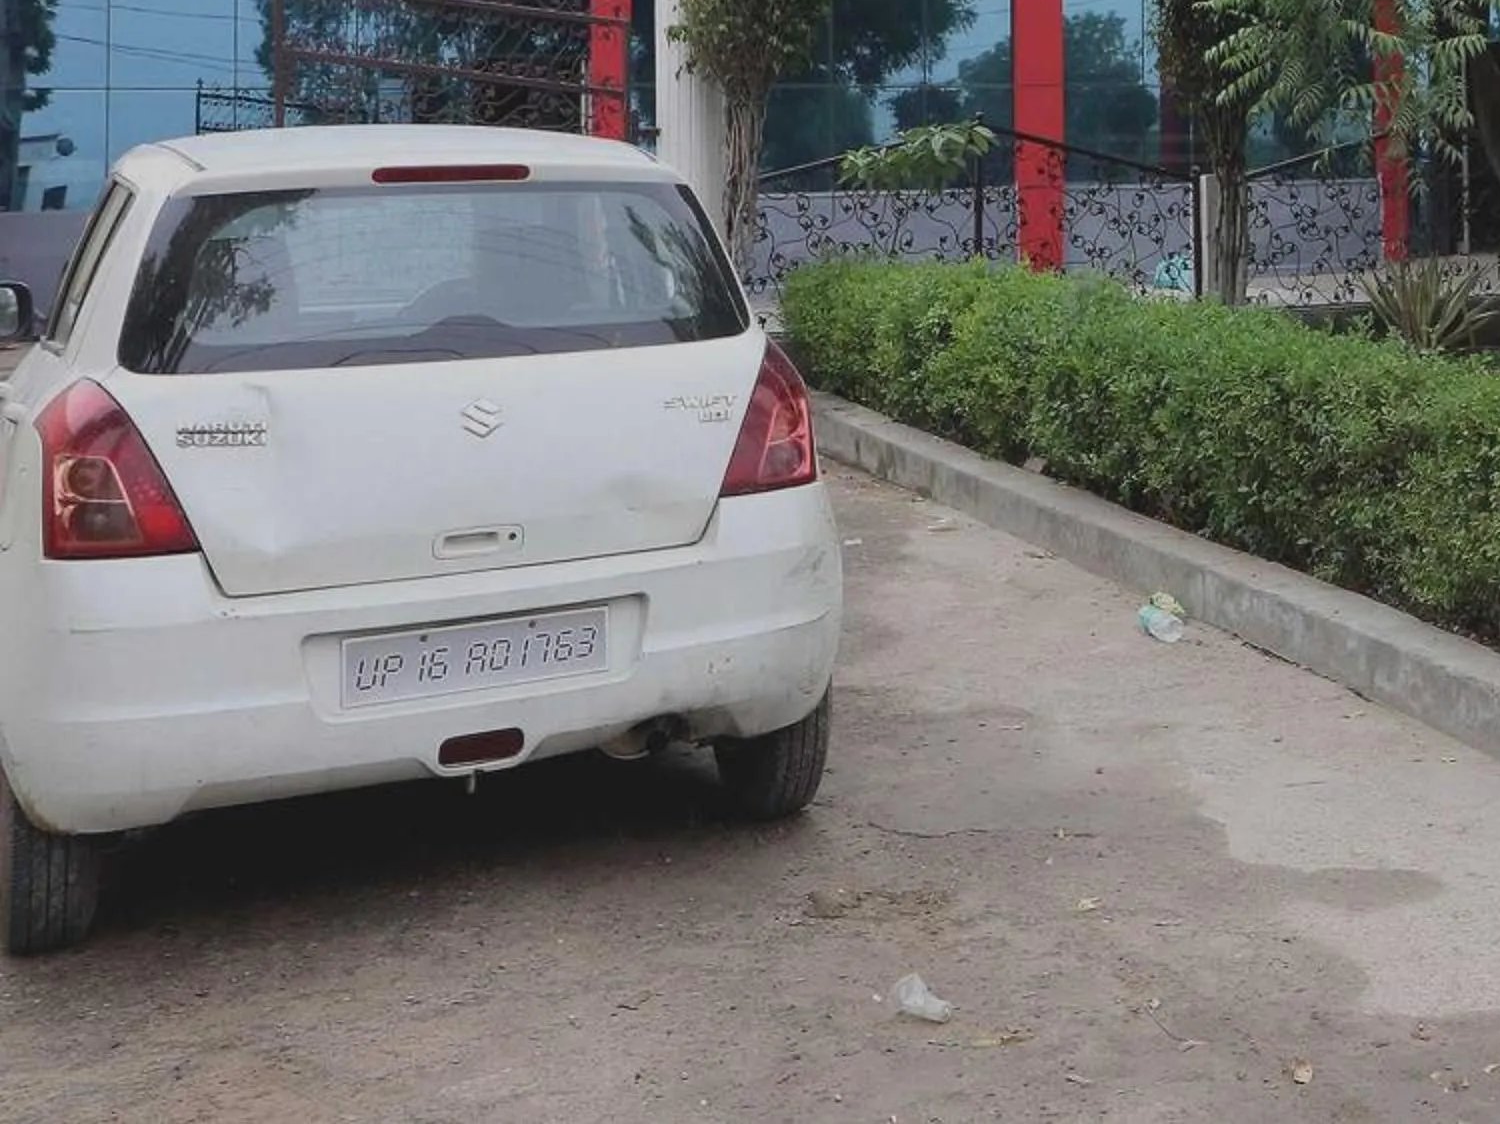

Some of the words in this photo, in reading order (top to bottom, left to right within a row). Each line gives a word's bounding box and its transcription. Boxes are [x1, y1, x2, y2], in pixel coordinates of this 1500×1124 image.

[176, 432, 267, 448] SUZUKI
[356, 655, 404, 691] UP
[419, 647, 449, 682] 16
